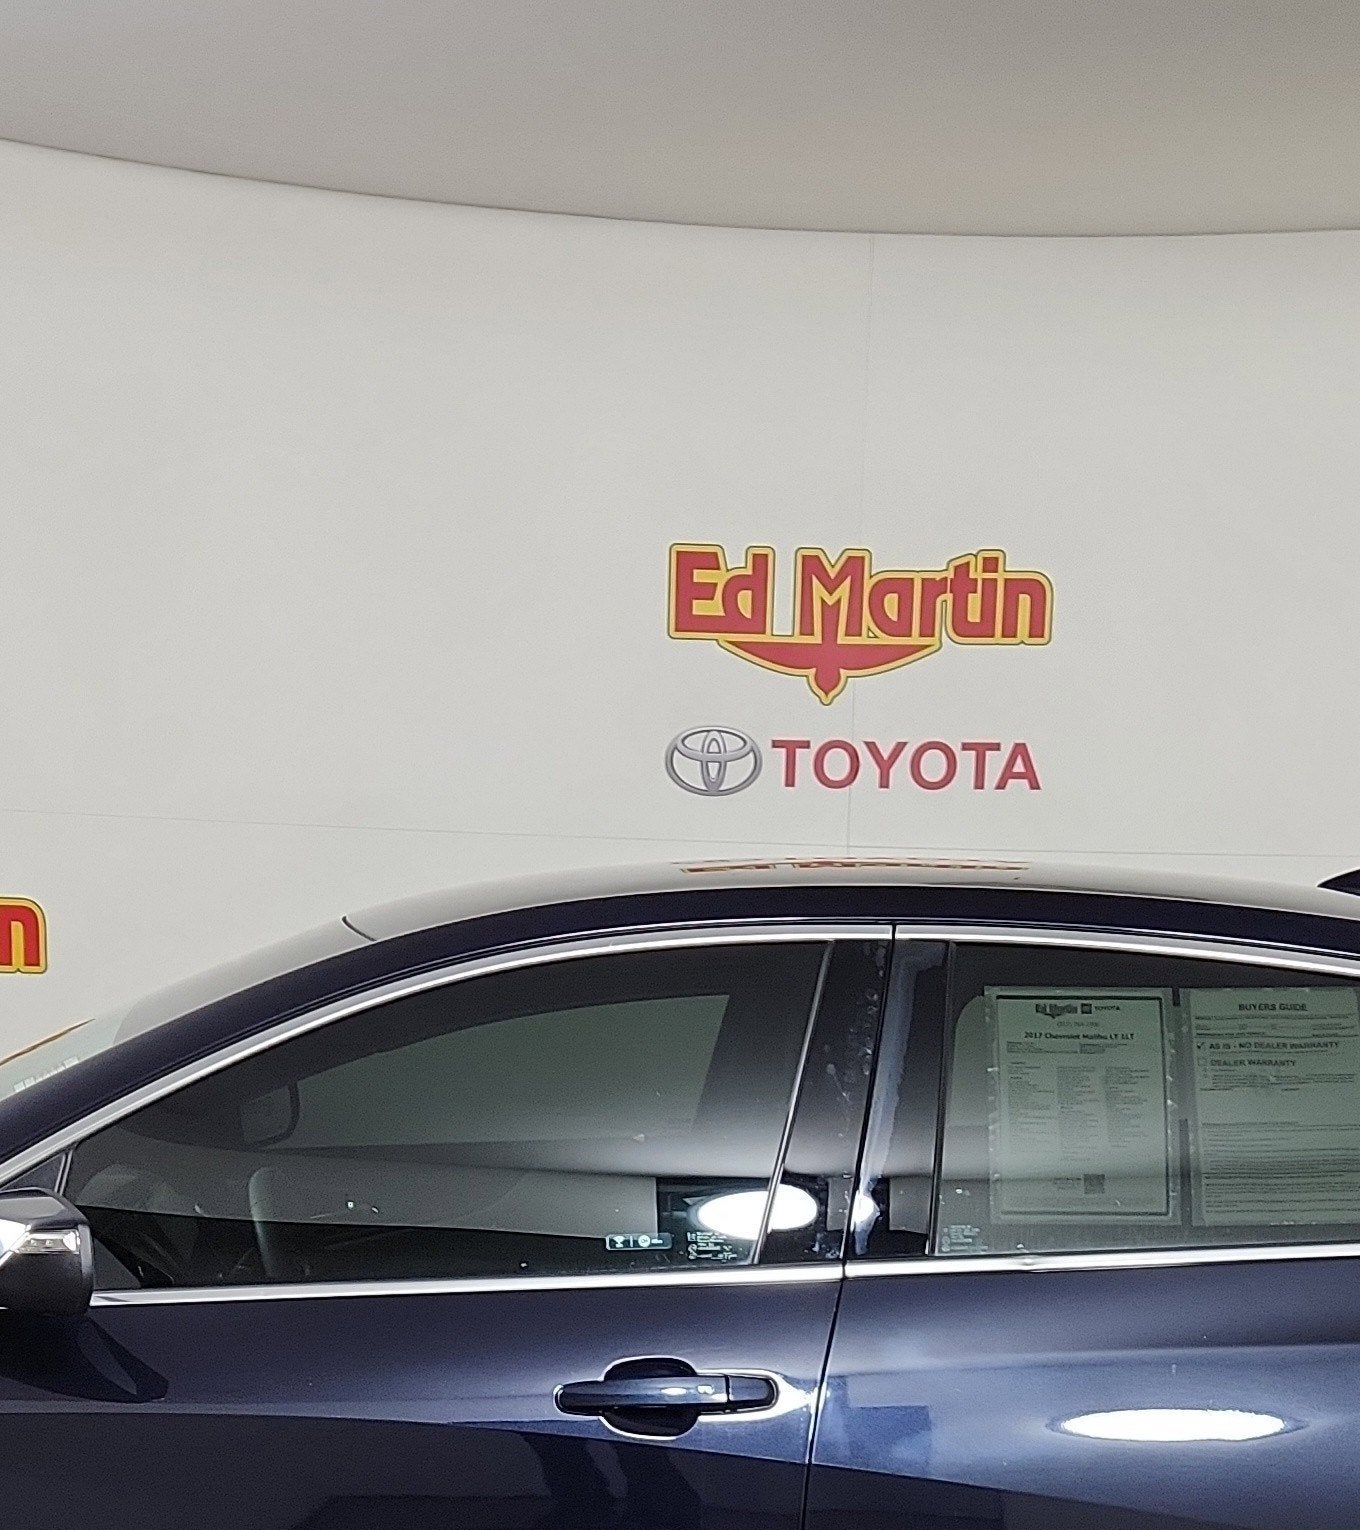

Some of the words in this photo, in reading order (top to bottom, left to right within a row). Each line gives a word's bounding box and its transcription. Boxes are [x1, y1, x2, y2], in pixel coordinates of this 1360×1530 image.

[669, 543, 776, 640] Ed
[795, 546, 1053, 646] Martin
[772, 739, 1042, 791] TOYOTA
[1238, 1003, 1277, 1011] BUYERS
[1279, 1003, 1308, 1011] GUIDE
[1024, 1031, 1043, 1040] 2017
[1044, 1031, 1081, 1040] Chevrolet
[1082, 1032, 1108, 1040] Malibu
[1209, 1042, 1221, 1050] AS
[1223, 1042, 1231, 1050] IS
[1238, 1042, 1252, 1050] NO
[1254, 1041, 1288, 1050] DEALER
[1289, 1041, 1339, 1050] WARRANTY
[1210, 1058, 1246, 1067] DEALER
[1247, 1059, 1297, 1067] WARRANTY
